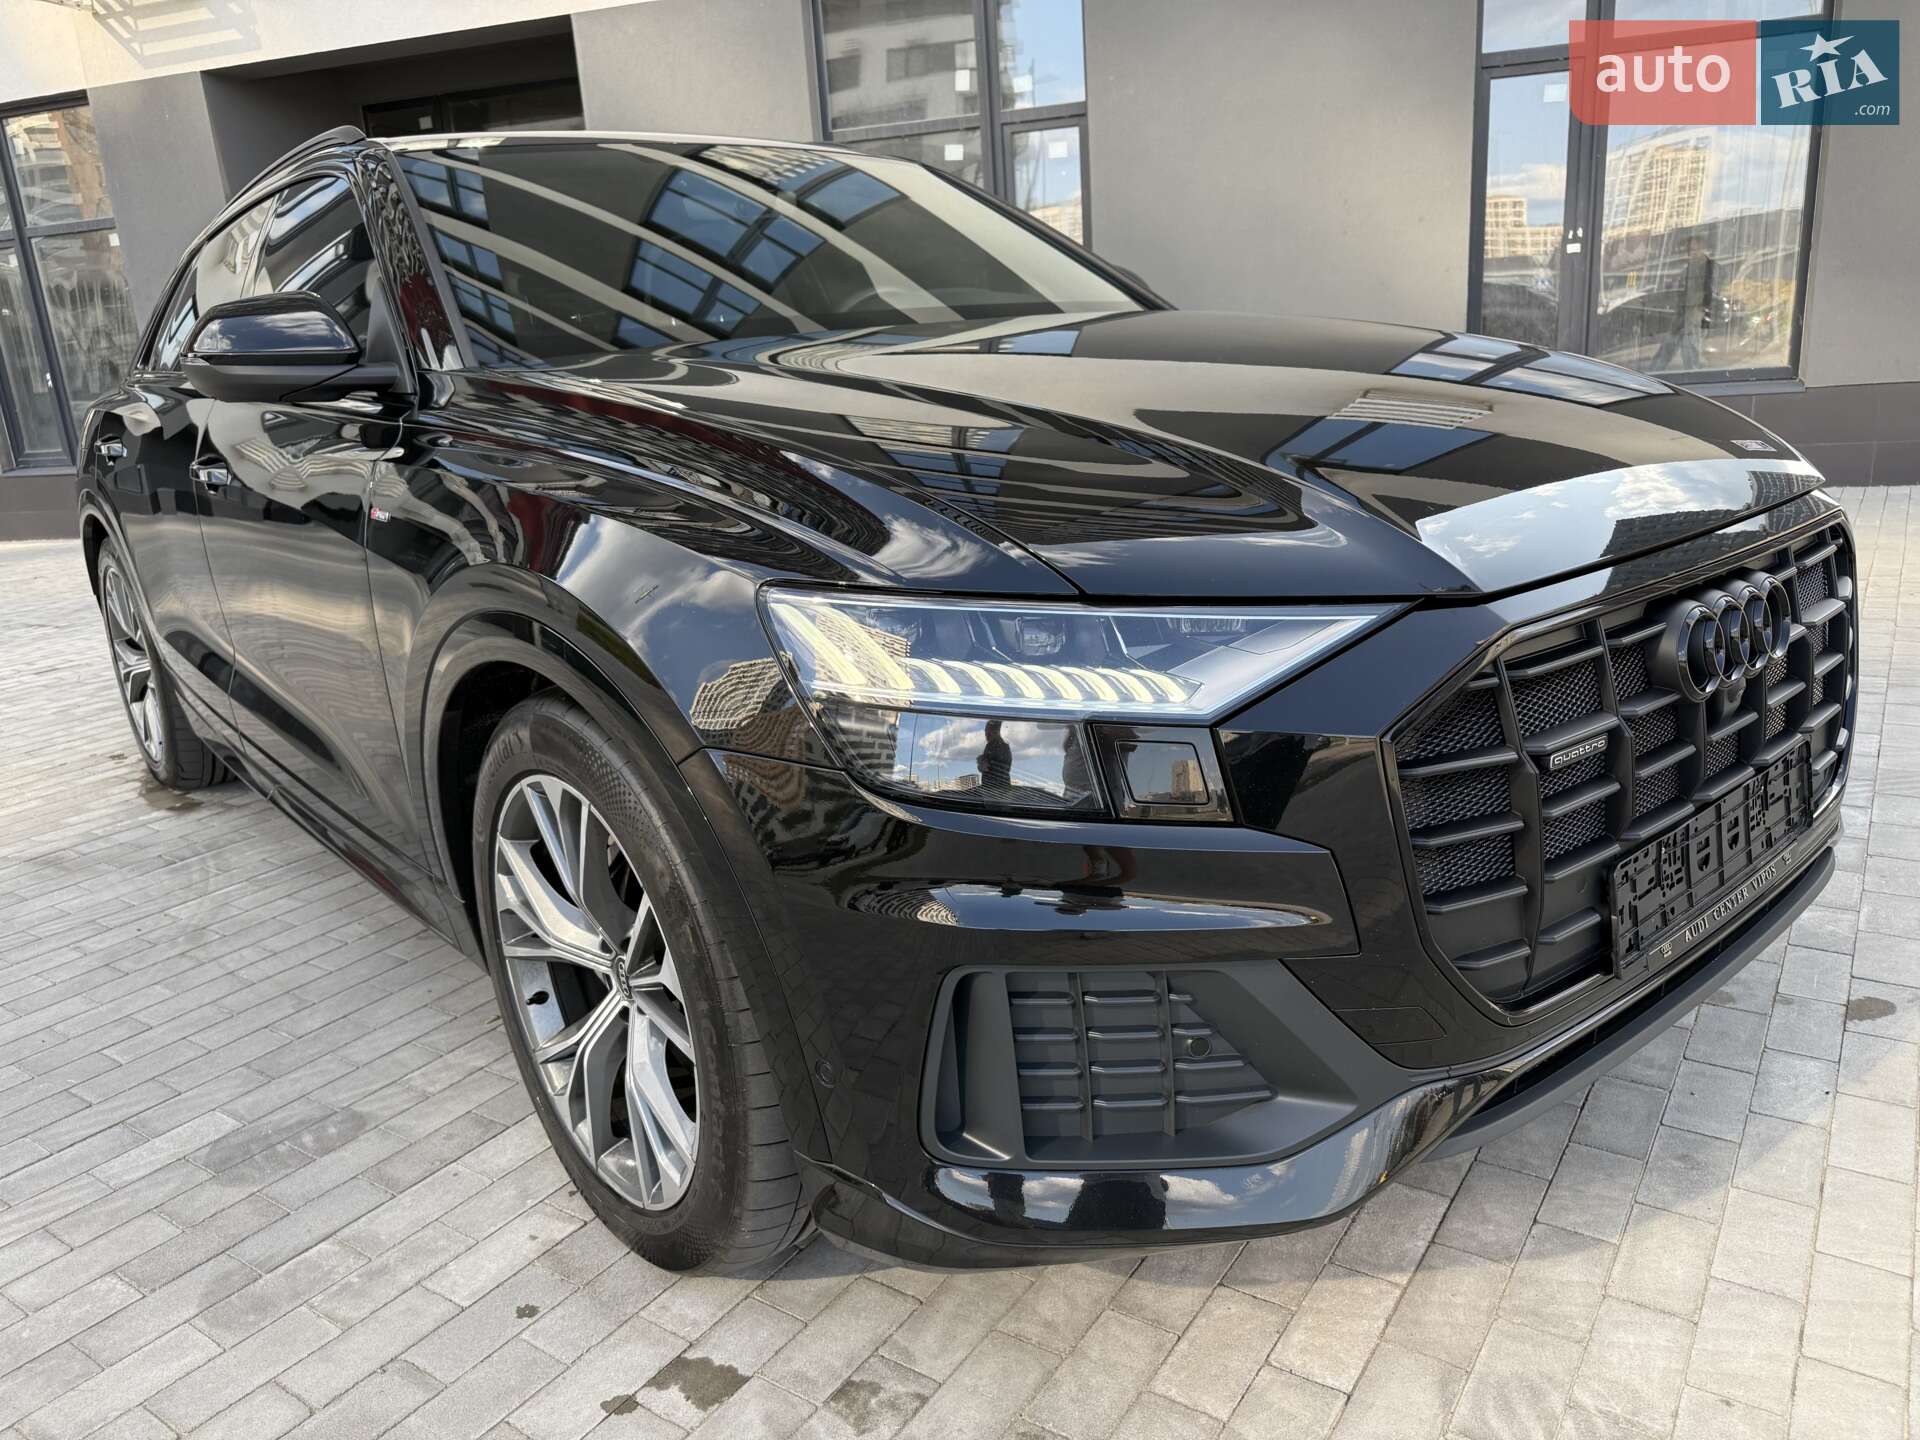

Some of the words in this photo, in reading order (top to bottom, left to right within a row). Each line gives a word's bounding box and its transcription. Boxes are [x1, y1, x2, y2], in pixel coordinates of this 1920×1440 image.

[1554, 740, 1605, 765] quattro
[1684, 917, 1709, 942] AUDI
[1713, 886, 1749, 921] CENTER
[1750, 863, 1777, 890] VIPOS
